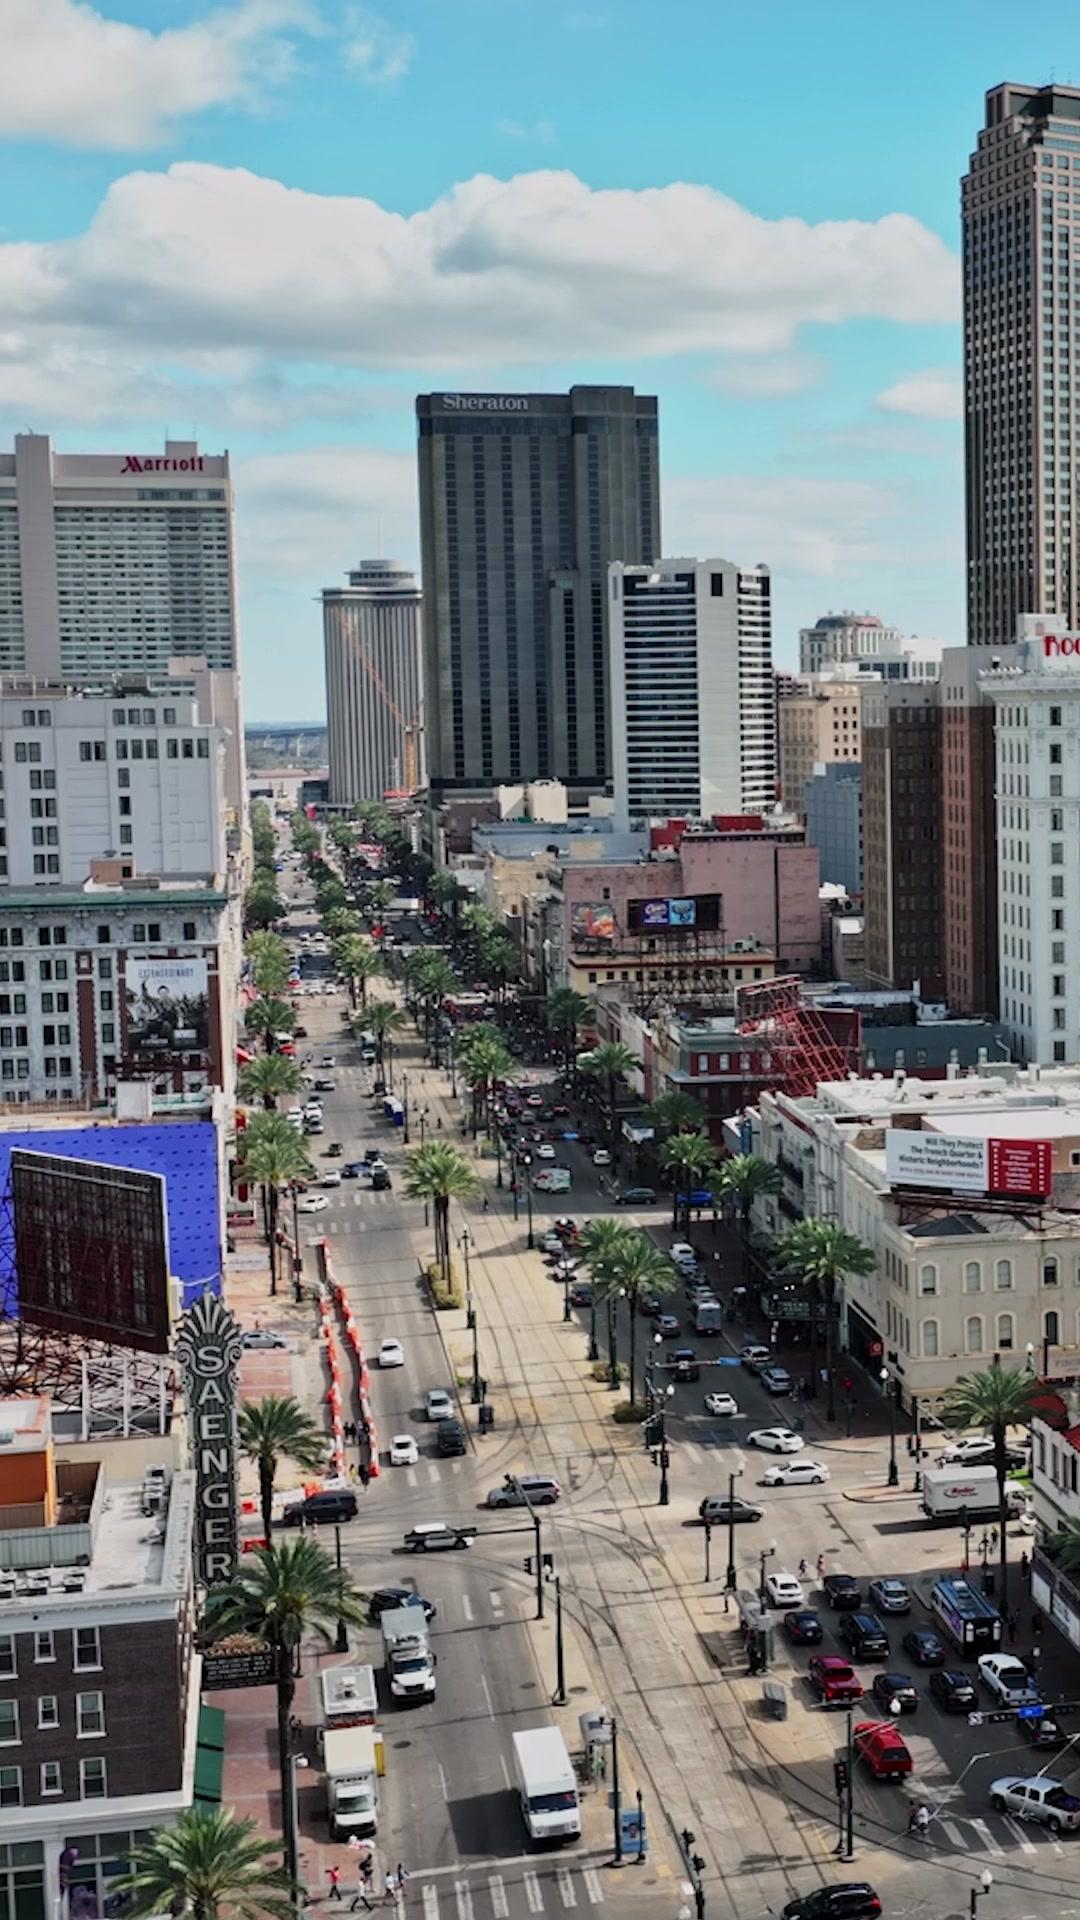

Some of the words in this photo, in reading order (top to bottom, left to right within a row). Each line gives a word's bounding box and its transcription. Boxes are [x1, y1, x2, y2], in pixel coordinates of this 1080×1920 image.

[442, 394, 529, 410] Sheraton
[120, 456, 203, 473] Marriott
[939, 1138, 956, 1149] They
[957, 1140, 983, 1150] Protect
[899, 1155, 925, 1164] Historic
[911, 1145, 922, 1153] The
[924, 1147, 947, 1156] French
[949, 1148, 976, 1158] Quarter
[978, 1151, 983, 1159] &
[199, 1345, 233, 1579] SAENGER
